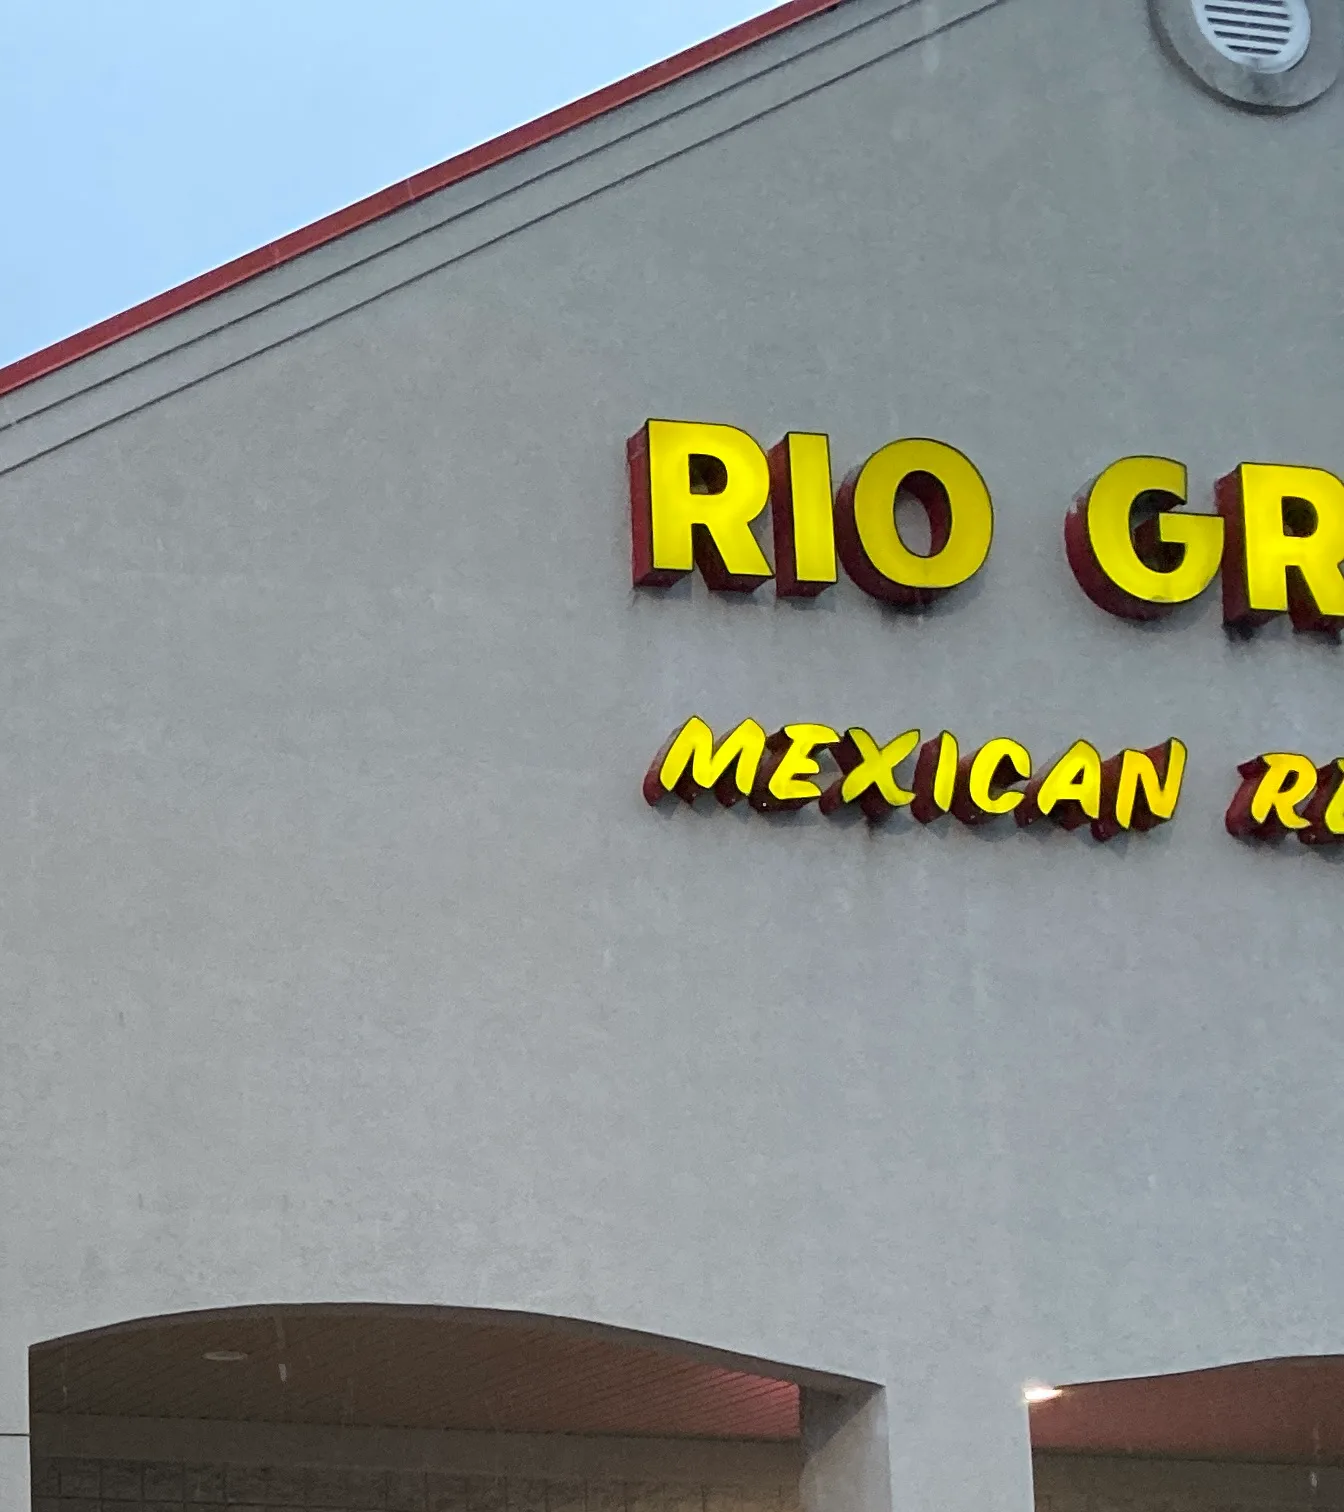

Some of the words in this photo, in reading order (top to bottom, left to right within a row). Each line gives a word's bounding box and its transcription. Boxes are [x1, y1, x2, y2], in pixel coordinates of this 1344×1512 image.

[630, 418, 994, 596] RIO
[1069, 455, 1344, 624] GR
[650, 715, 1187, 836] MEXICAN
